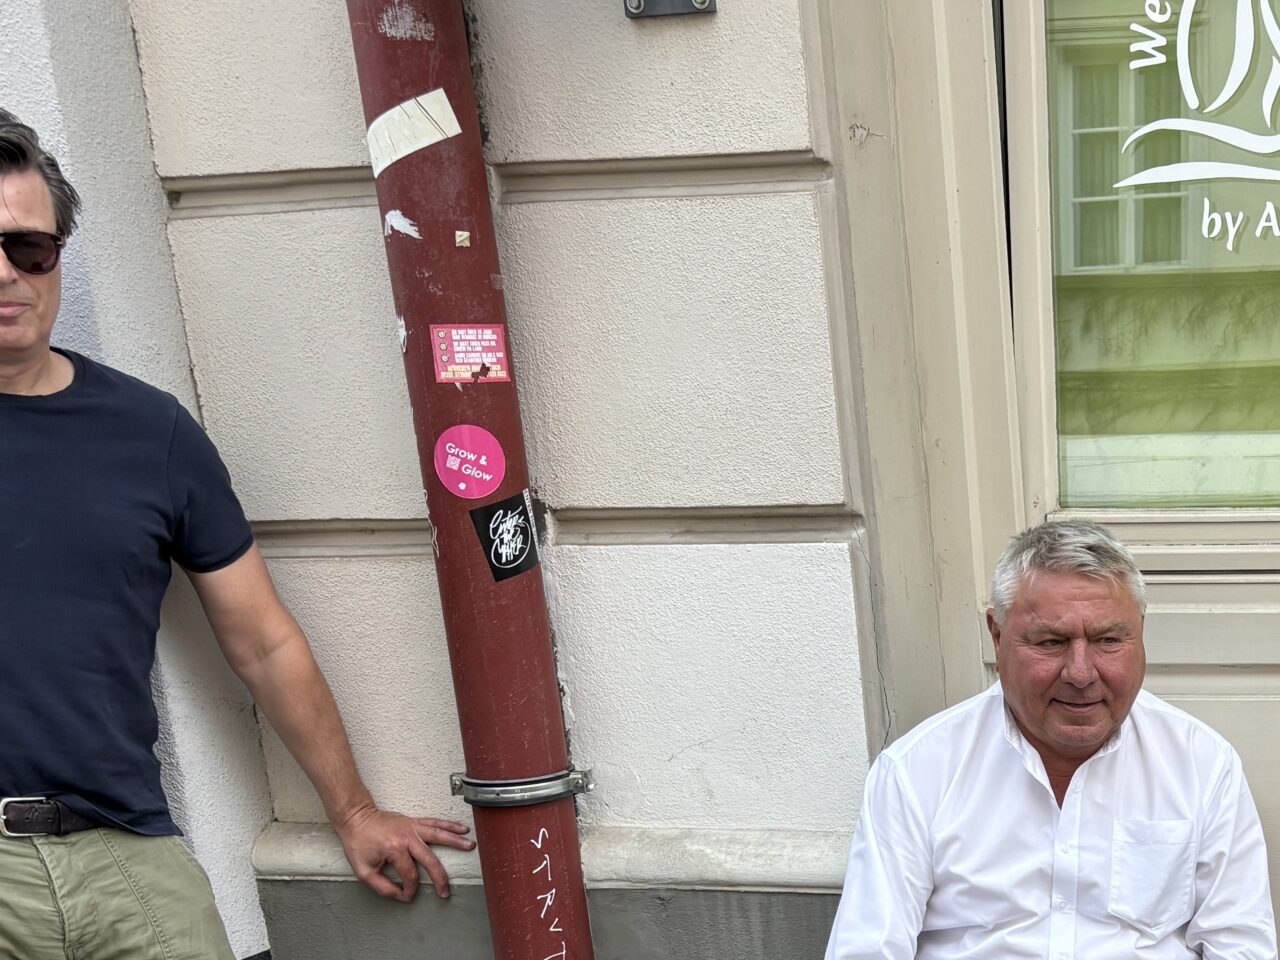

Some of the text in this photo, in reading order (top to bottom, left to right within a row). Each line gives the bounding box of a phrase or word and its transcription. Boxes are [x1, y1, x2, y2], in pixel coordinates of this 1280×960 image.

[1202, 197, 1244, 250] by
[445, 443, 488, 466] Grow &
[461, 463, 493, 482] Glow
